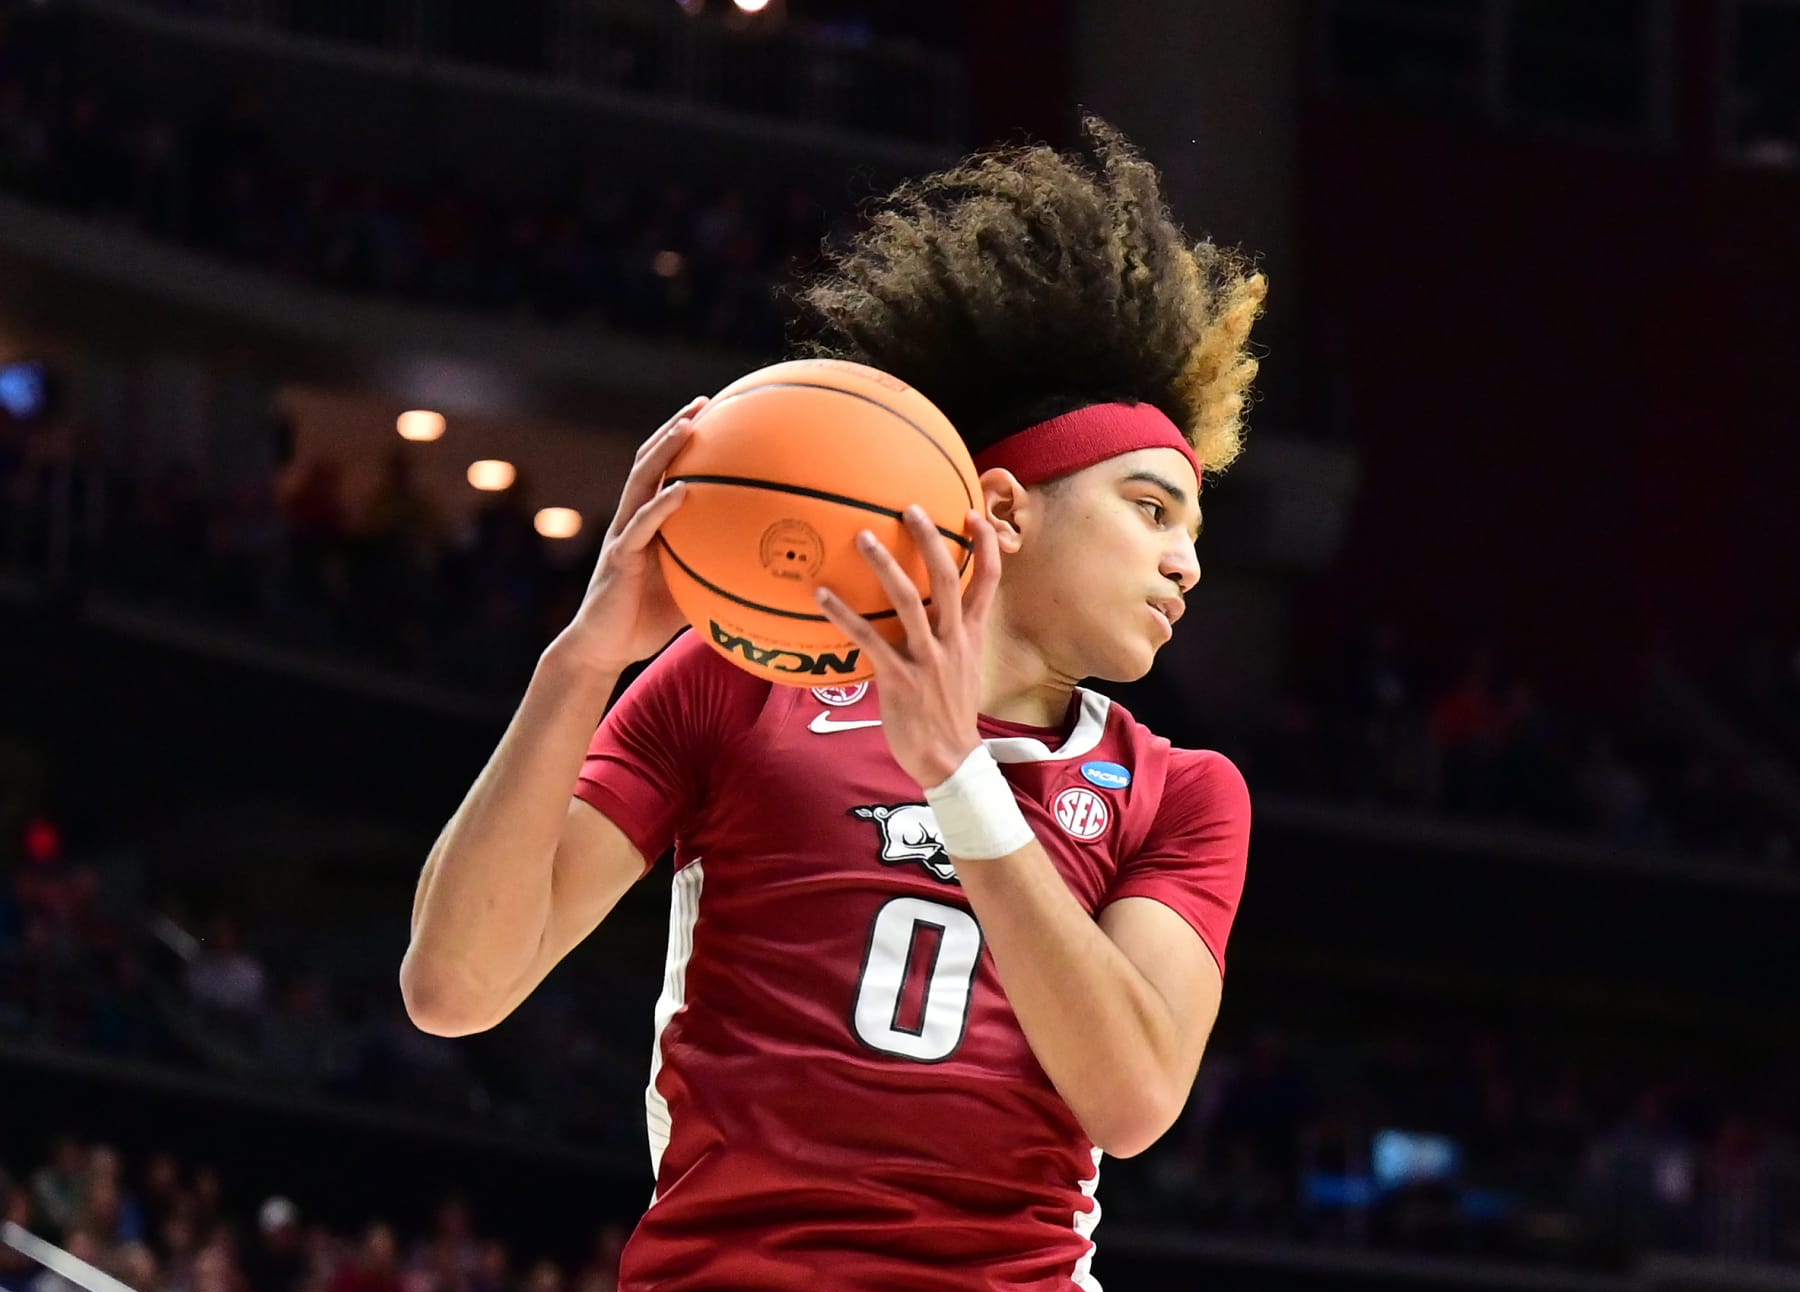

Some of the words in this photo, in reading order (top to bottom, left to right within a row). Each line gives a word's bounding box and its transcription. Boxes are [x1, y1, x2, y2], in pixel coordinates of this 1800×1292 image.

[709, 619, 861, 675] NCAA
[1058, 791, 1105, 837] SEC
[852, 896, 985, 1063] 0
